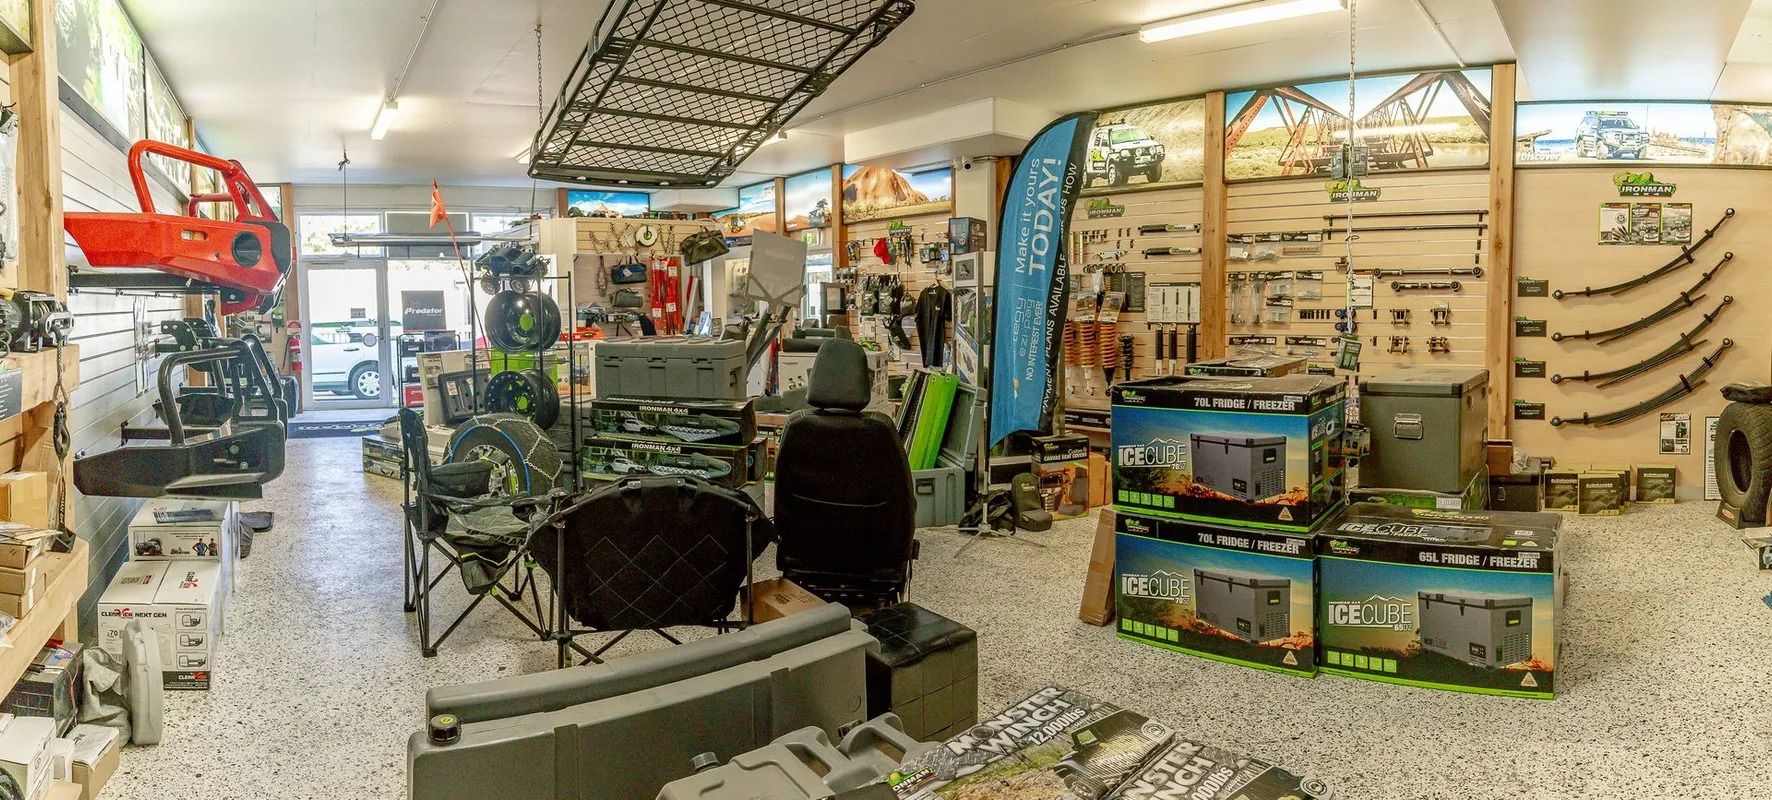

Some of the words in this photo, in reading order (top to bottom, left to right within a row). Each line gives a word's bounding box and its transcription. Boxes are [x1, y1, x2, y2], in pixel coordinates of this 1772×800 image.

[1024, 158, 1040, 207] yours
[1062, 162, 1078, 195] HOW
[1020, 212, 1032, 222] it
[1028, 158, 1061, 276] TODAY!
[1015, 229, 1030, 274] Make
[405, 306, 444, 316] Predator
[1027, 327, 1041, 367] INTEREST
[1026, 367, 1035, 381] NO
[639, 405, 674, 413] IRONMAN
[1194, 397, 1211, 408] 70L
[1212, 398, 1245, 409] FRIDGE
[1253, 400, 1295, 411] FREEZER
[631, 443, 666, 451] IRONMAN
[1198, 533, 1215, 544] 70L
[1216, 535, 1250, 549] FRIDGE
[1257, 540, 1300, 554] FREEZER
[1418, 551, 1439, 563] 65L
[1441, 552, 1480, 566] FRIDGE
[1489, 555, 1538, 569] FREEZER
[946, 687, 1067, 756] MONSTER
[978, 699, 1072, 755] WINCH
[1028, 707, 1087, 746] 12,000lbs
[892, 769, 930, 792] ONMAN
